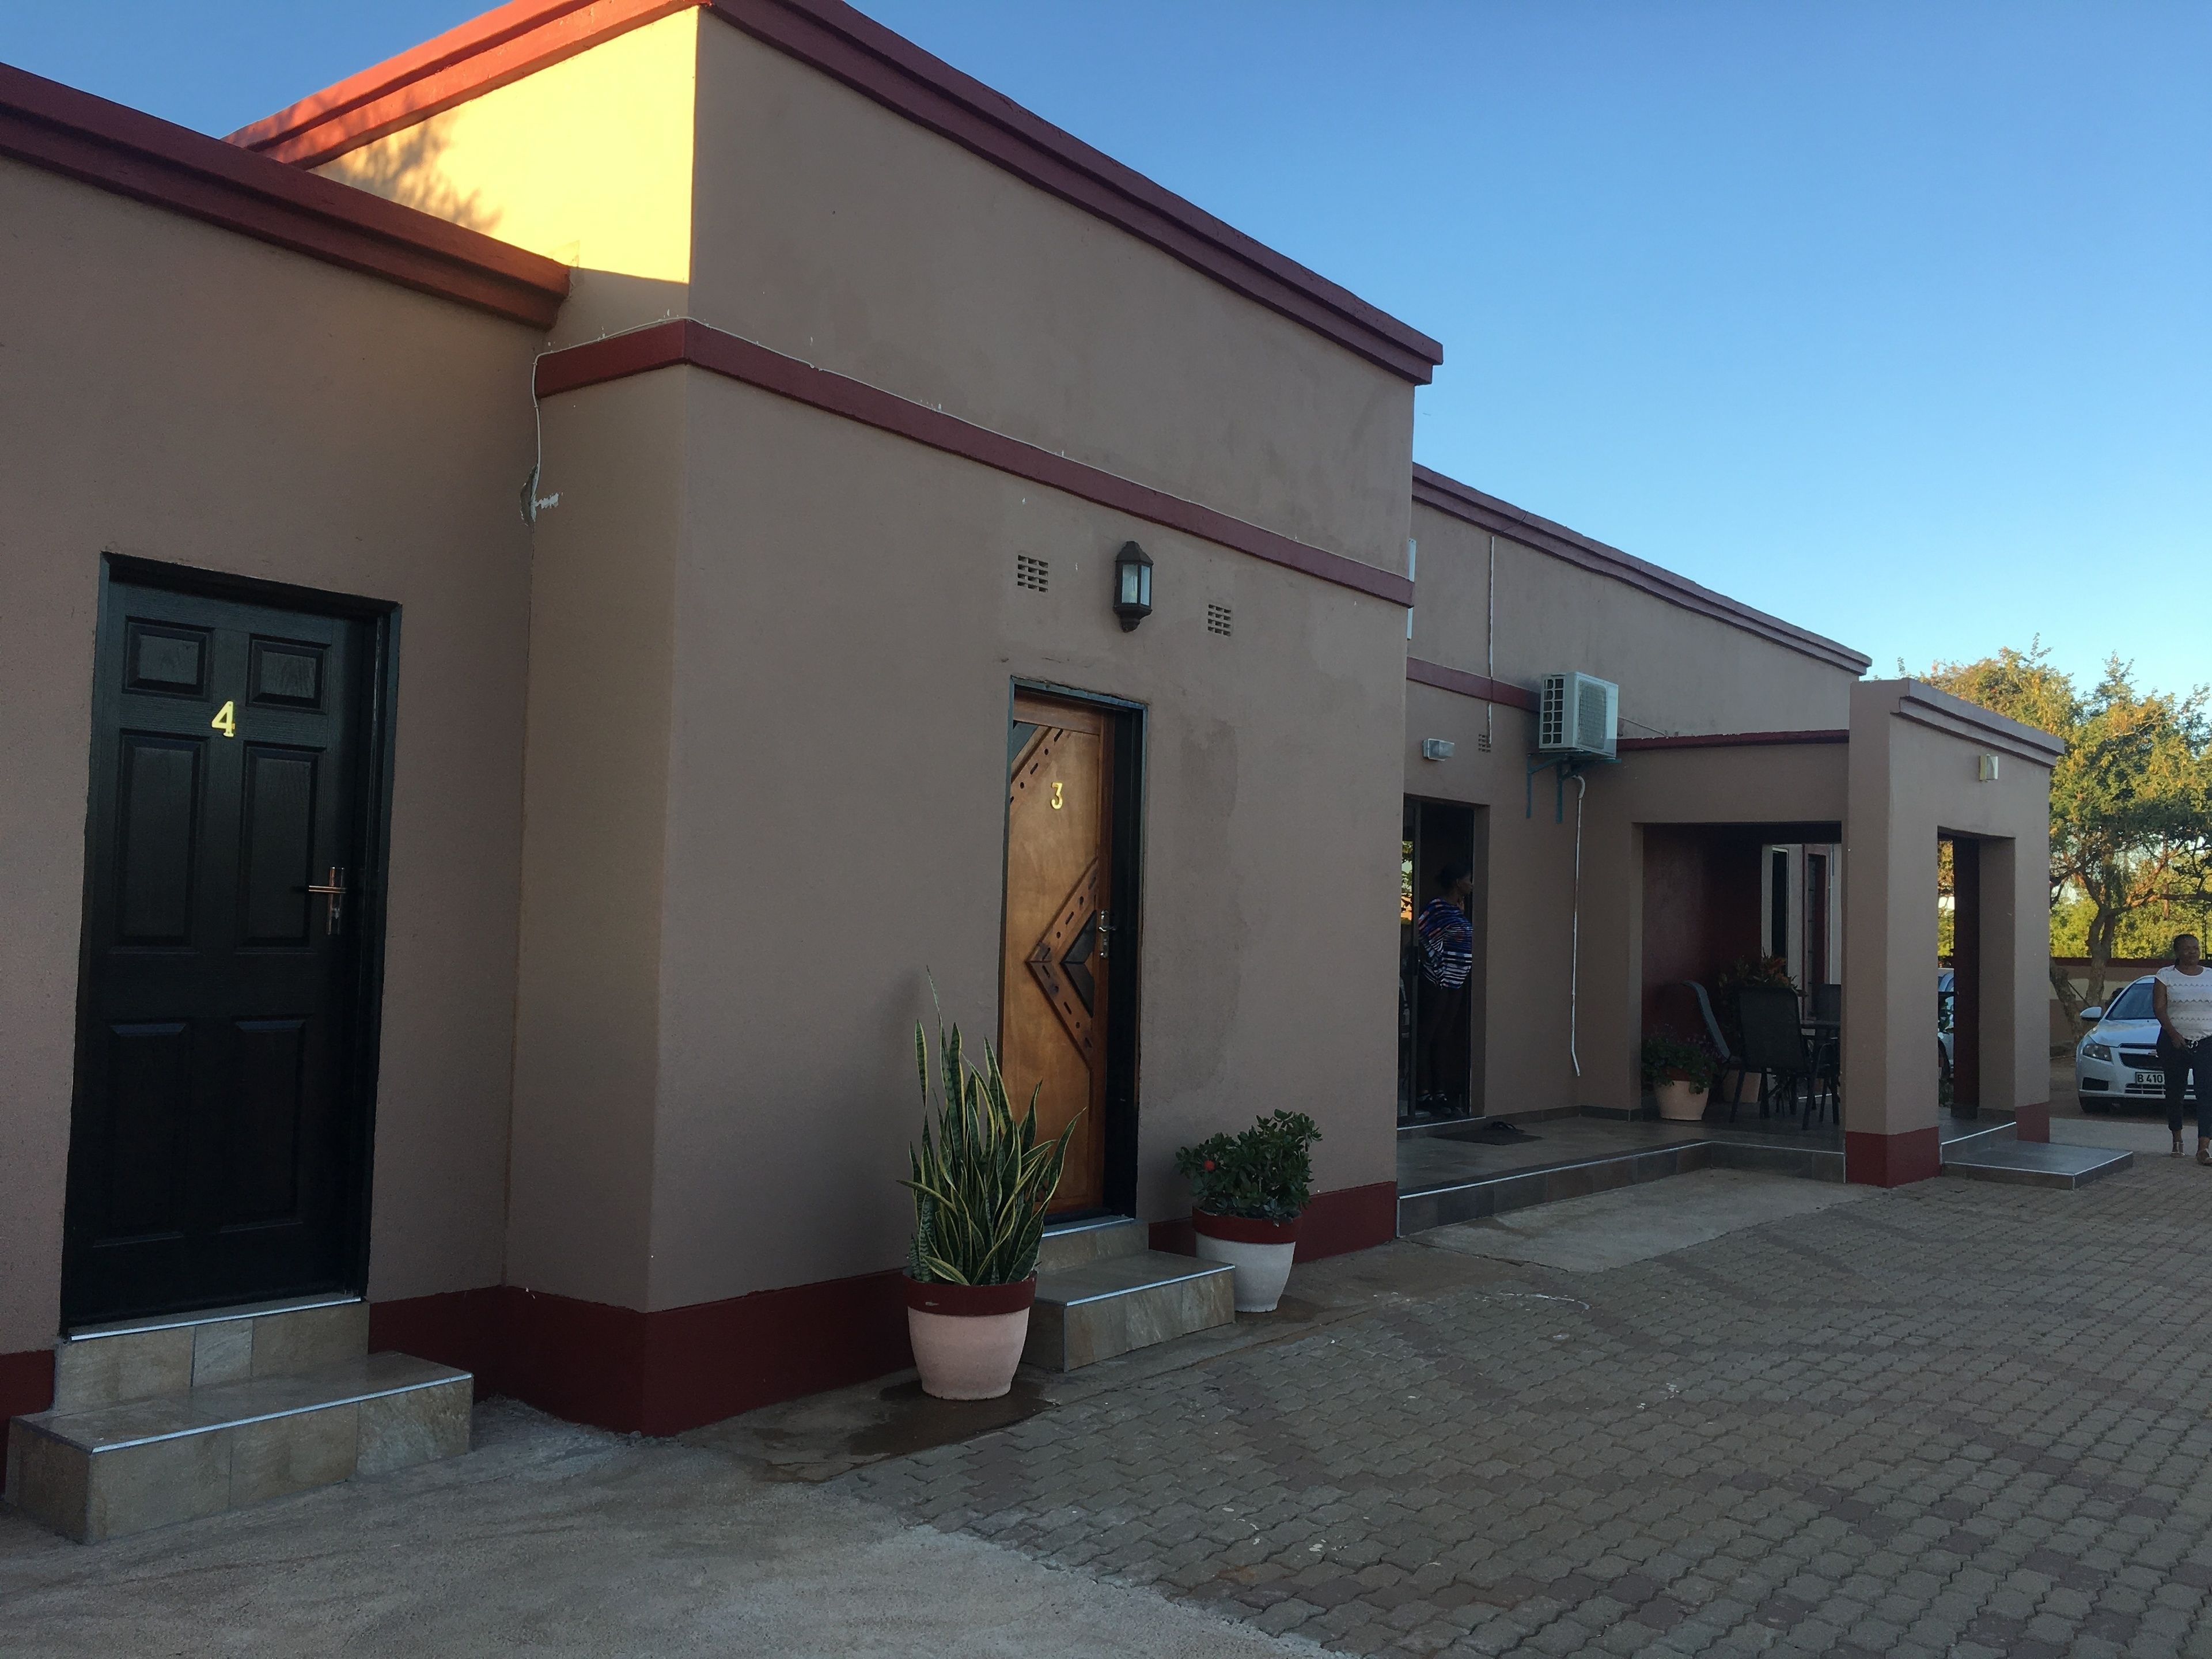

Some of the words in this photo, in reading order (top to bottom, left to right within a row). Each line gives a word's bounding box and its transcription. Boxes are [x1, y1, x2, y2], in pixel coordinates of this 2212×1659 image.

[212, 700, 235, 737] 4
[1051, 782, 1063, 809] 3
[2138, 1074, 2143, 1082] B
[2146, 1074, 2163, 1083] 410
